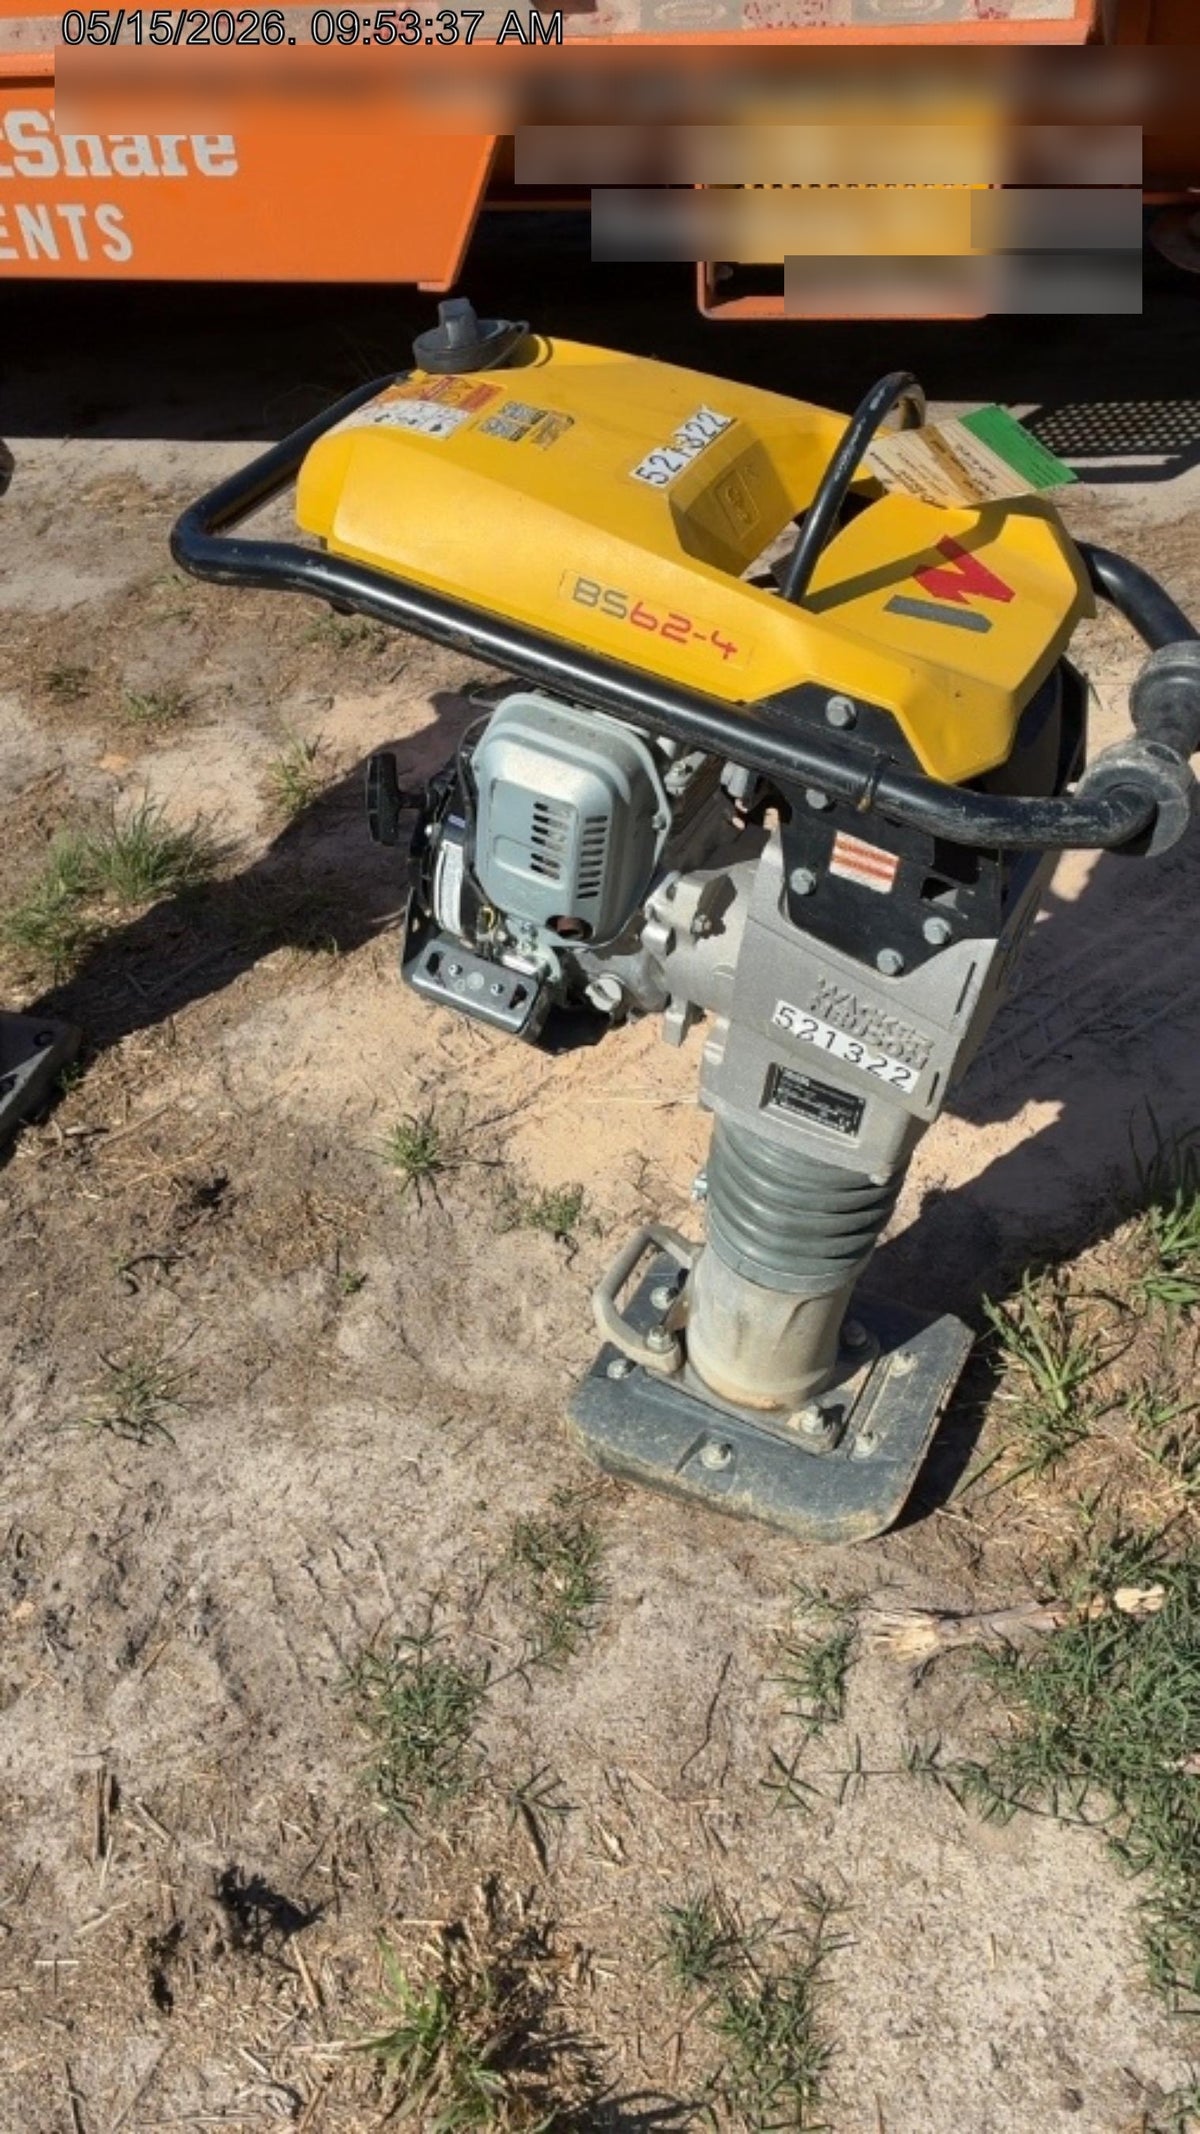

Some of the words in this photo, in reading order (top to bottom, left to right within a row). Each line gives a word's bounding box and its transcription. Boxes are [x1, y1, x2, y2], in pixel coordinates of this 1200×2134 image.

[0, 109, 239, 177] Share
[635, 412, 729, 484] 521322
[573, 577, 738, 660] BS62-4
[772, 1005, 914, 1090] 521322
